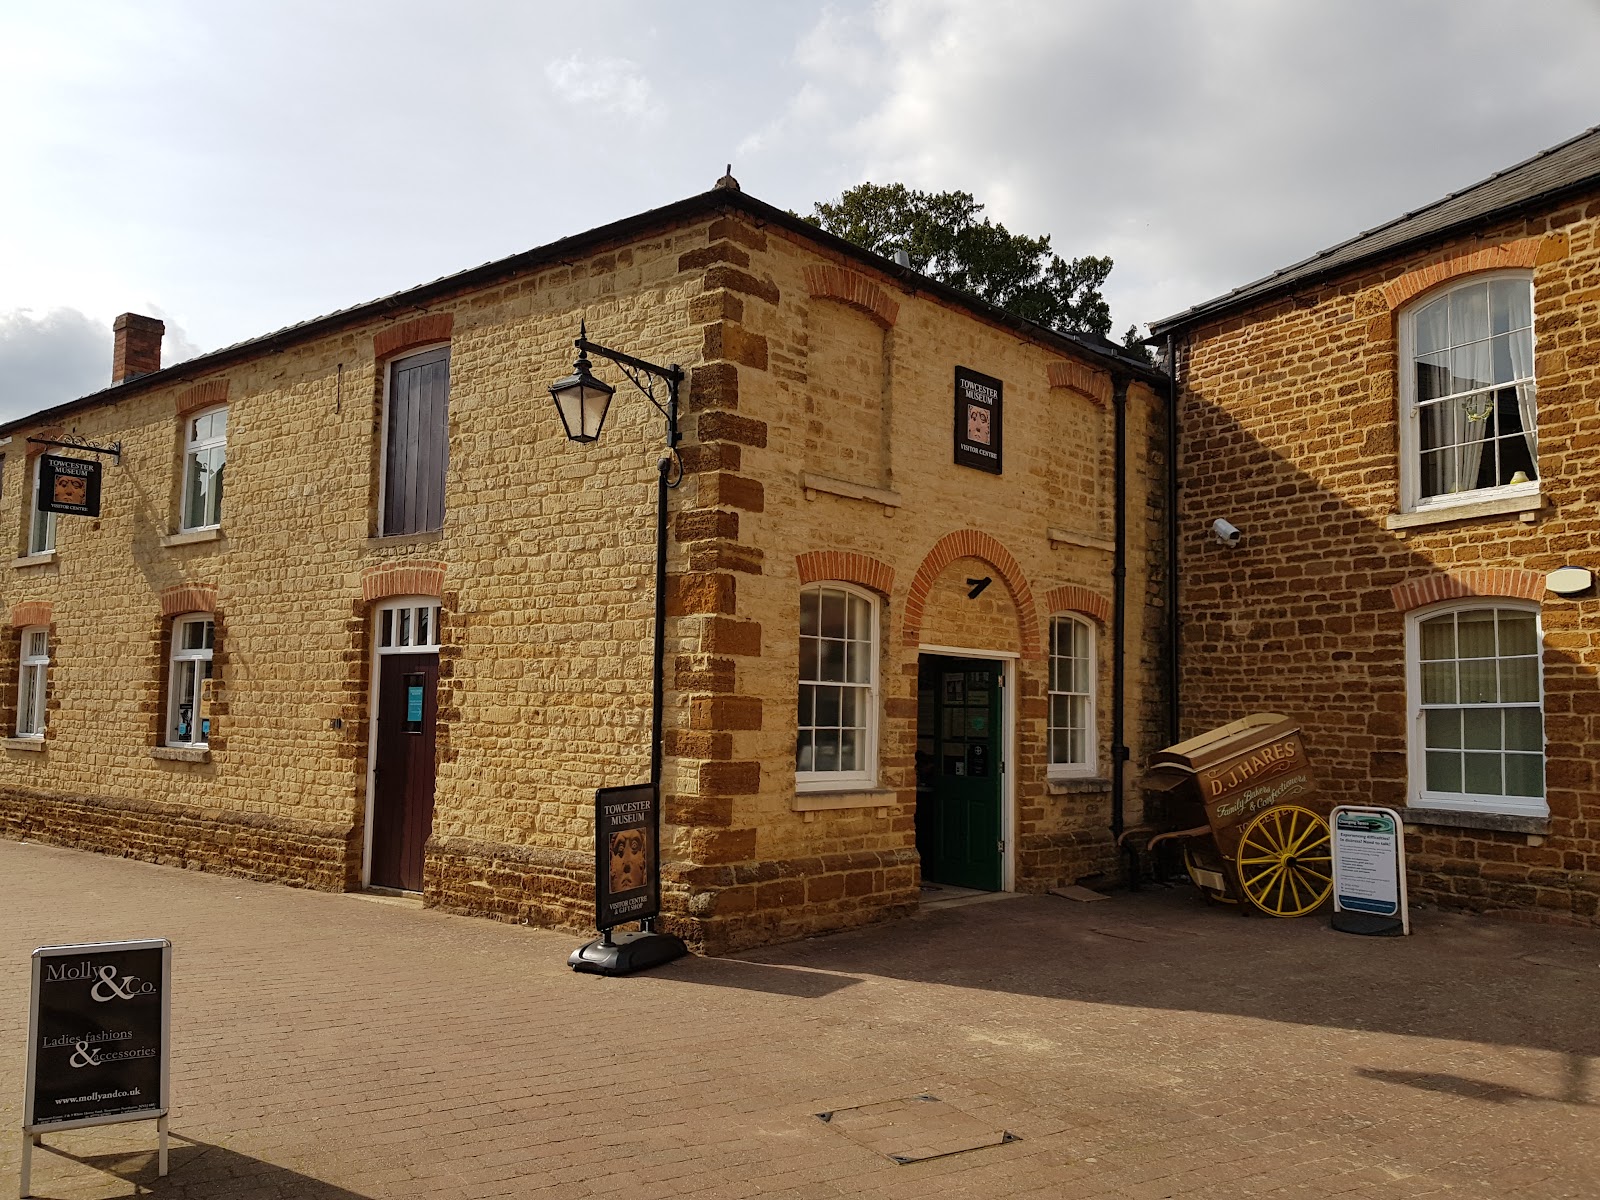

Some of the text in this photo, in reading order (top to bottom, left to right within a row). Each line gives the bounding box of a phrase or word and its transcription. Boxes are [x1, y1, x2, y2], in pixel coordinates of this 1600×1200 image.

[960, 378, 998, 399] TOWCESTER
[965, 389, 993, 406] MUSEUM
[960, 442, 998, 460] VISITOR CENTRE
[48, 459, 94, 472] TOWCESTER
[54, 466, 88, 477] MUSEUM
[603, 800, 651, 815] TOWCESTER
[1216, 785, 1272, 818] Family Bakers
[1249, 801, 1258, 812] &
[610, 812, 646, 826] MUSEUM
[609, 895, 648, 910] VISITOR CENTRE
[630, 903, 644, 911] SHOP
[45, 961, 157, 1002] Molly & Co.
[43, 1029, 133, 1047] Ladies fashions
[69, 1041, 156, 1068] & accessories
[54, 1086, 141, 1105] www.mollyandco.uk
